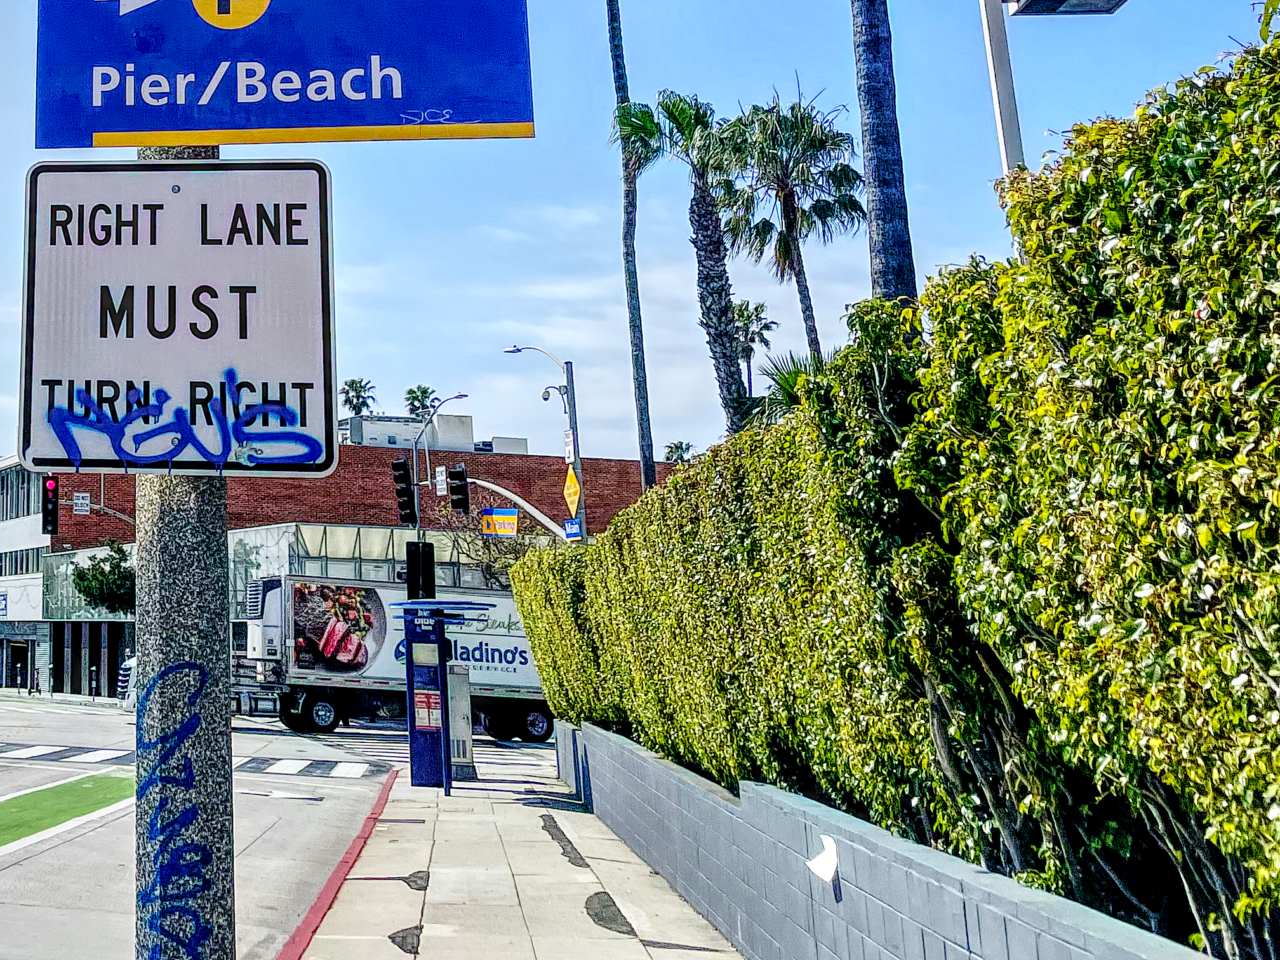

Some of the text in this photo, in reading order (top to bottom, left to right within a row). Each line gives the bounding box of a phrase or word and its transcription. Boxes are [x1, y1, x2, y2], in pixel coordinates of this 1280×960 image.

[91, 55, 404, 108] Pier/Beach
[49, 203, 309, 246] RIGHT LANE
[99, 285, 257, 339] MUST
[41, 379, 314, 427] TURN RIGHT
[494, 519, 515, 531] Parking
[565, 522, 580, 534] Main
[452, 639, 529, 666] ladino's
